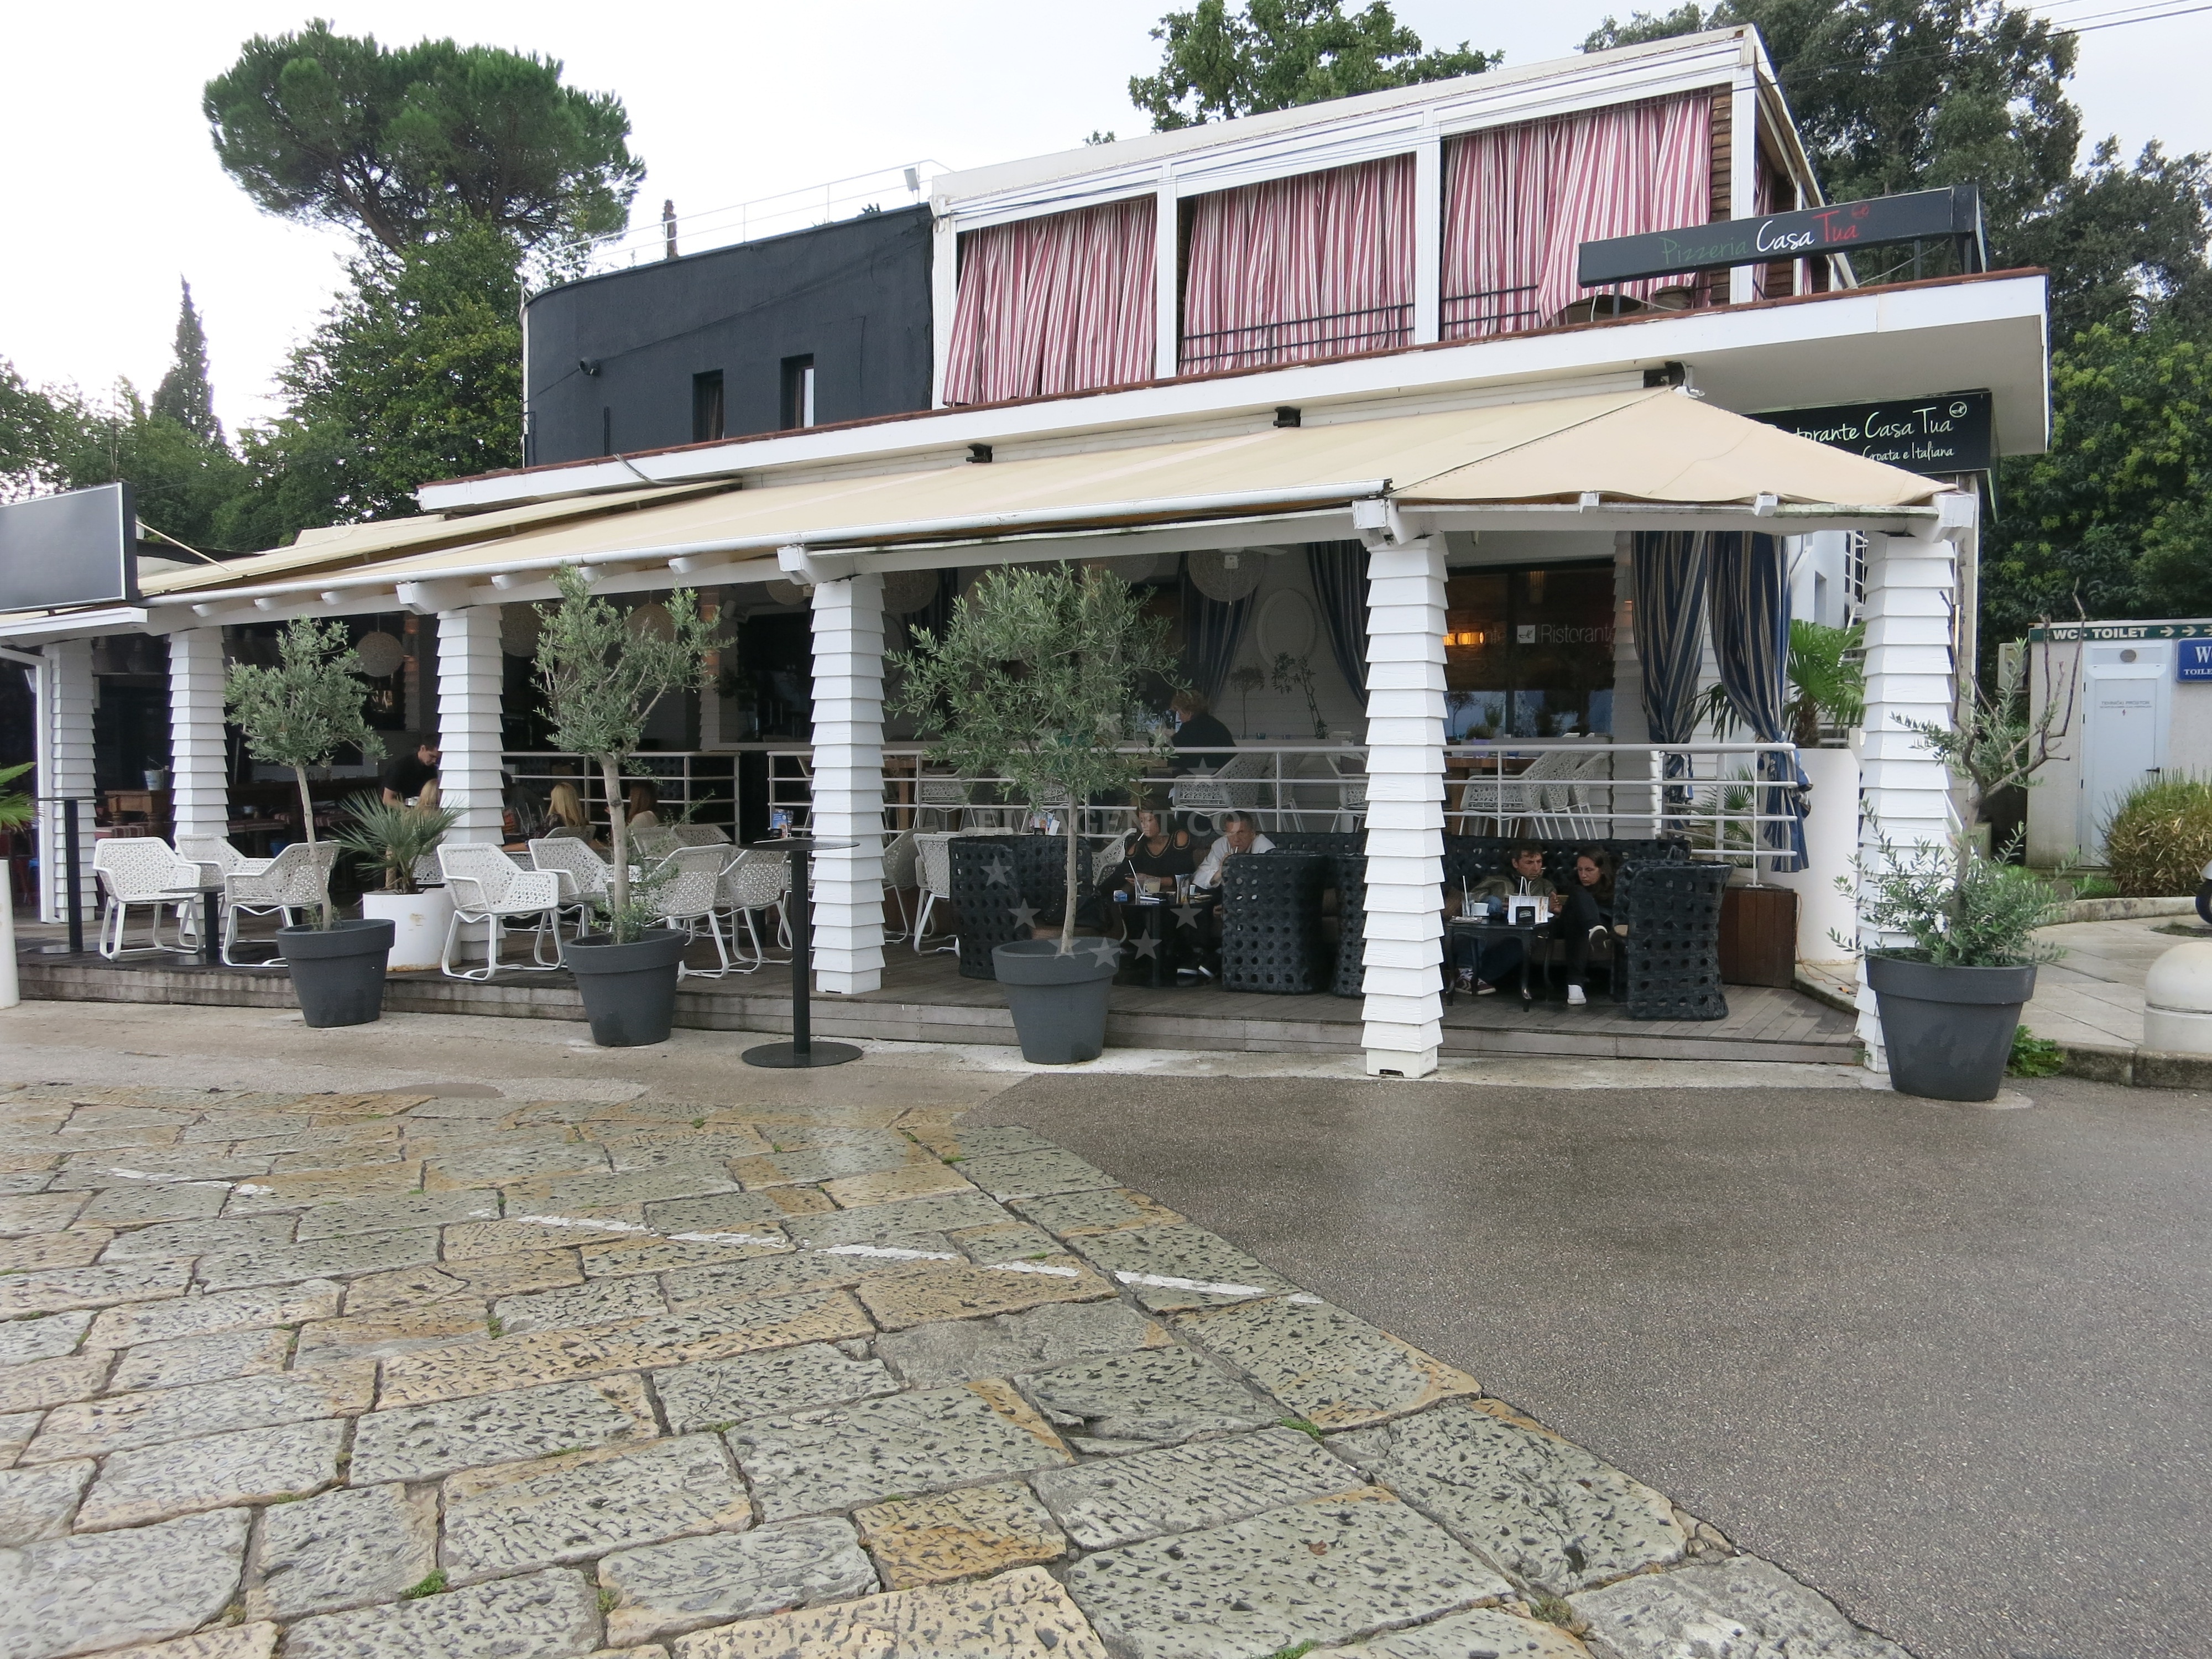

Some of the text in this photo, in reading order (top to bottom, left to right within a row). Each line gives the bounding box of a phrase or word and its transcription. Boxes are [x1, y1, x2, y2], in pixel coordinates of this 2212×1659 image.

[1659, 210, 1860, 264] Pizzeria Casa Tua
[1865, 411, 1915, 439] Casa
[1912, 406, 1954, 435] Tua
[1903, 451, 1910, 460] e
[1912, 441, 1954, 461] Italiana
[2053, 629, 2079, 640] WC
[2091, 627, 2148, 639] TOILET
[2194, 646, 2212, 664] W
